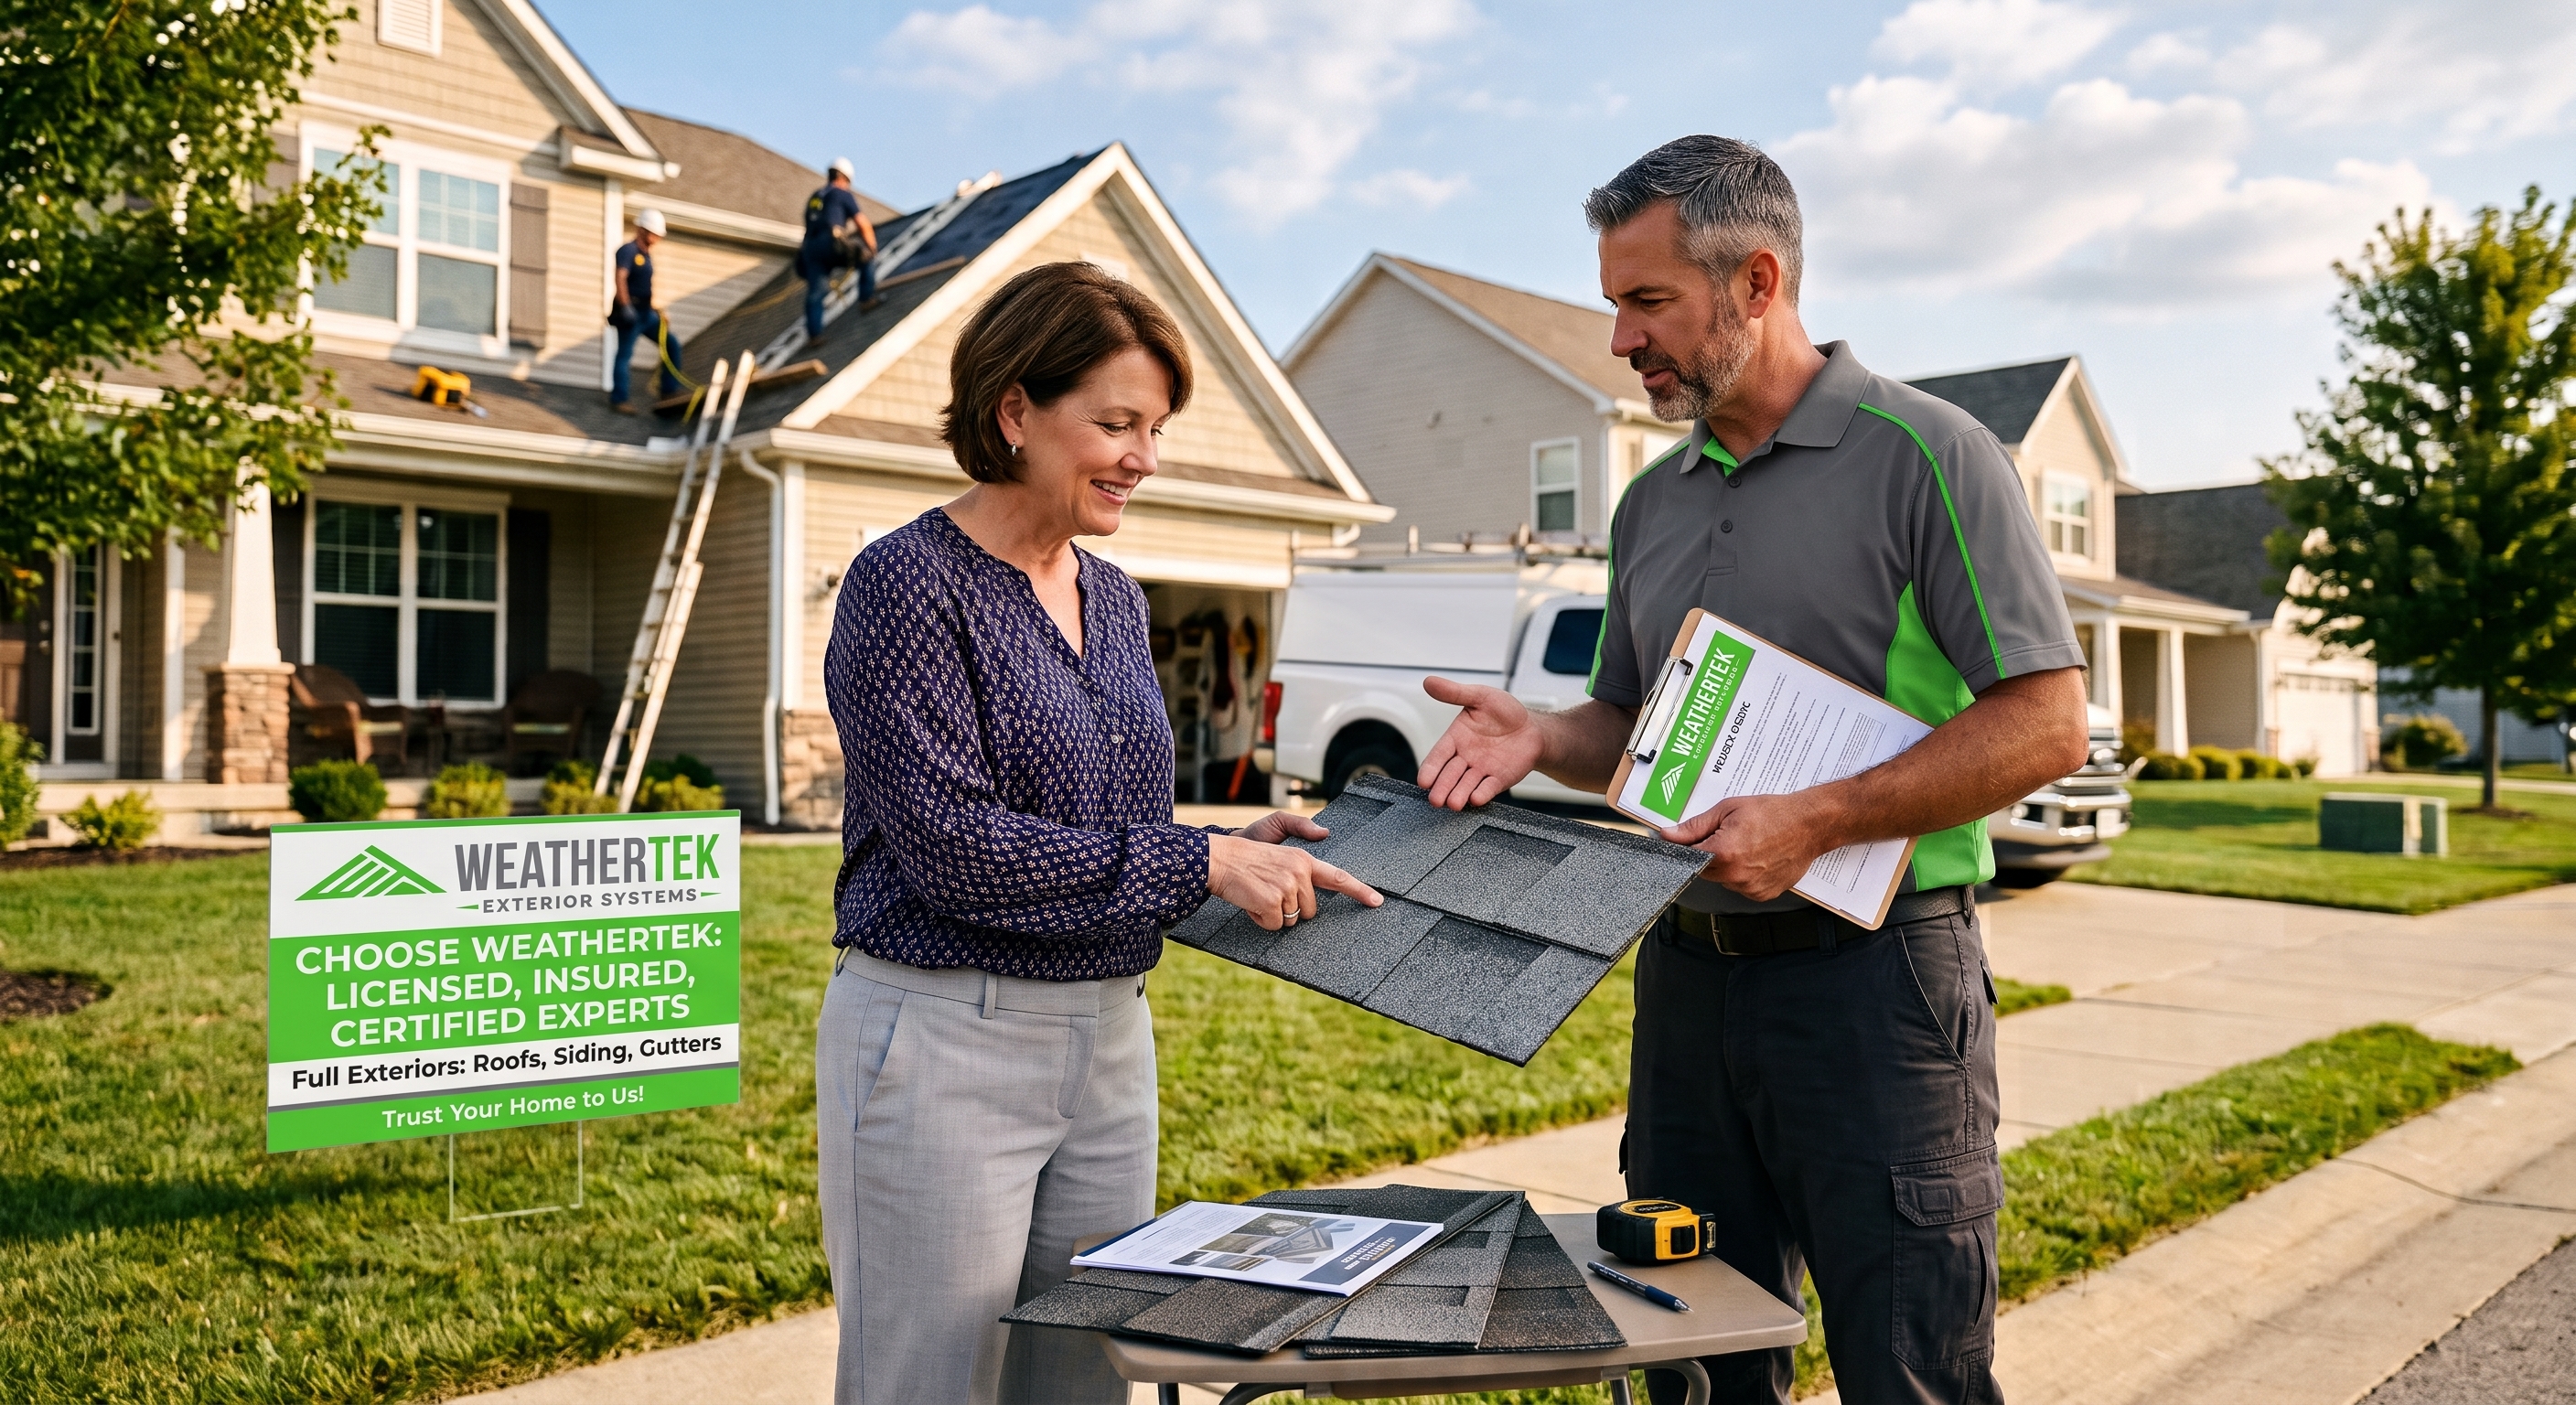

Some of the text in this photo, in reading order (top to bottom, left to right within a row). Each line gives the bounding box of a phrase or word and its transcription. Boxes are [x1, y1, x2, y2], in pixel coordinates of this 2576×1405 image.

[1671, 648, 1735, 756] WEATHERTEK
[455, 833, 721, 892] WEATHERTEK
[484, 888, 697, 914] EXTERIOR SYSTEMS
[295, 922, 722, 974] CHOOSE WEATHERTEK:
[327, 960, 695, 1010] LICENSED, INSURED,
[331, 994, 690, 1047] CERTIFIED EXPERTS
[292, 1035, 722, 1089] Full Exteriors: Roofs, Siding, Gutters
[382, 1085, 644, 1129] Trust Your Home to Us!
